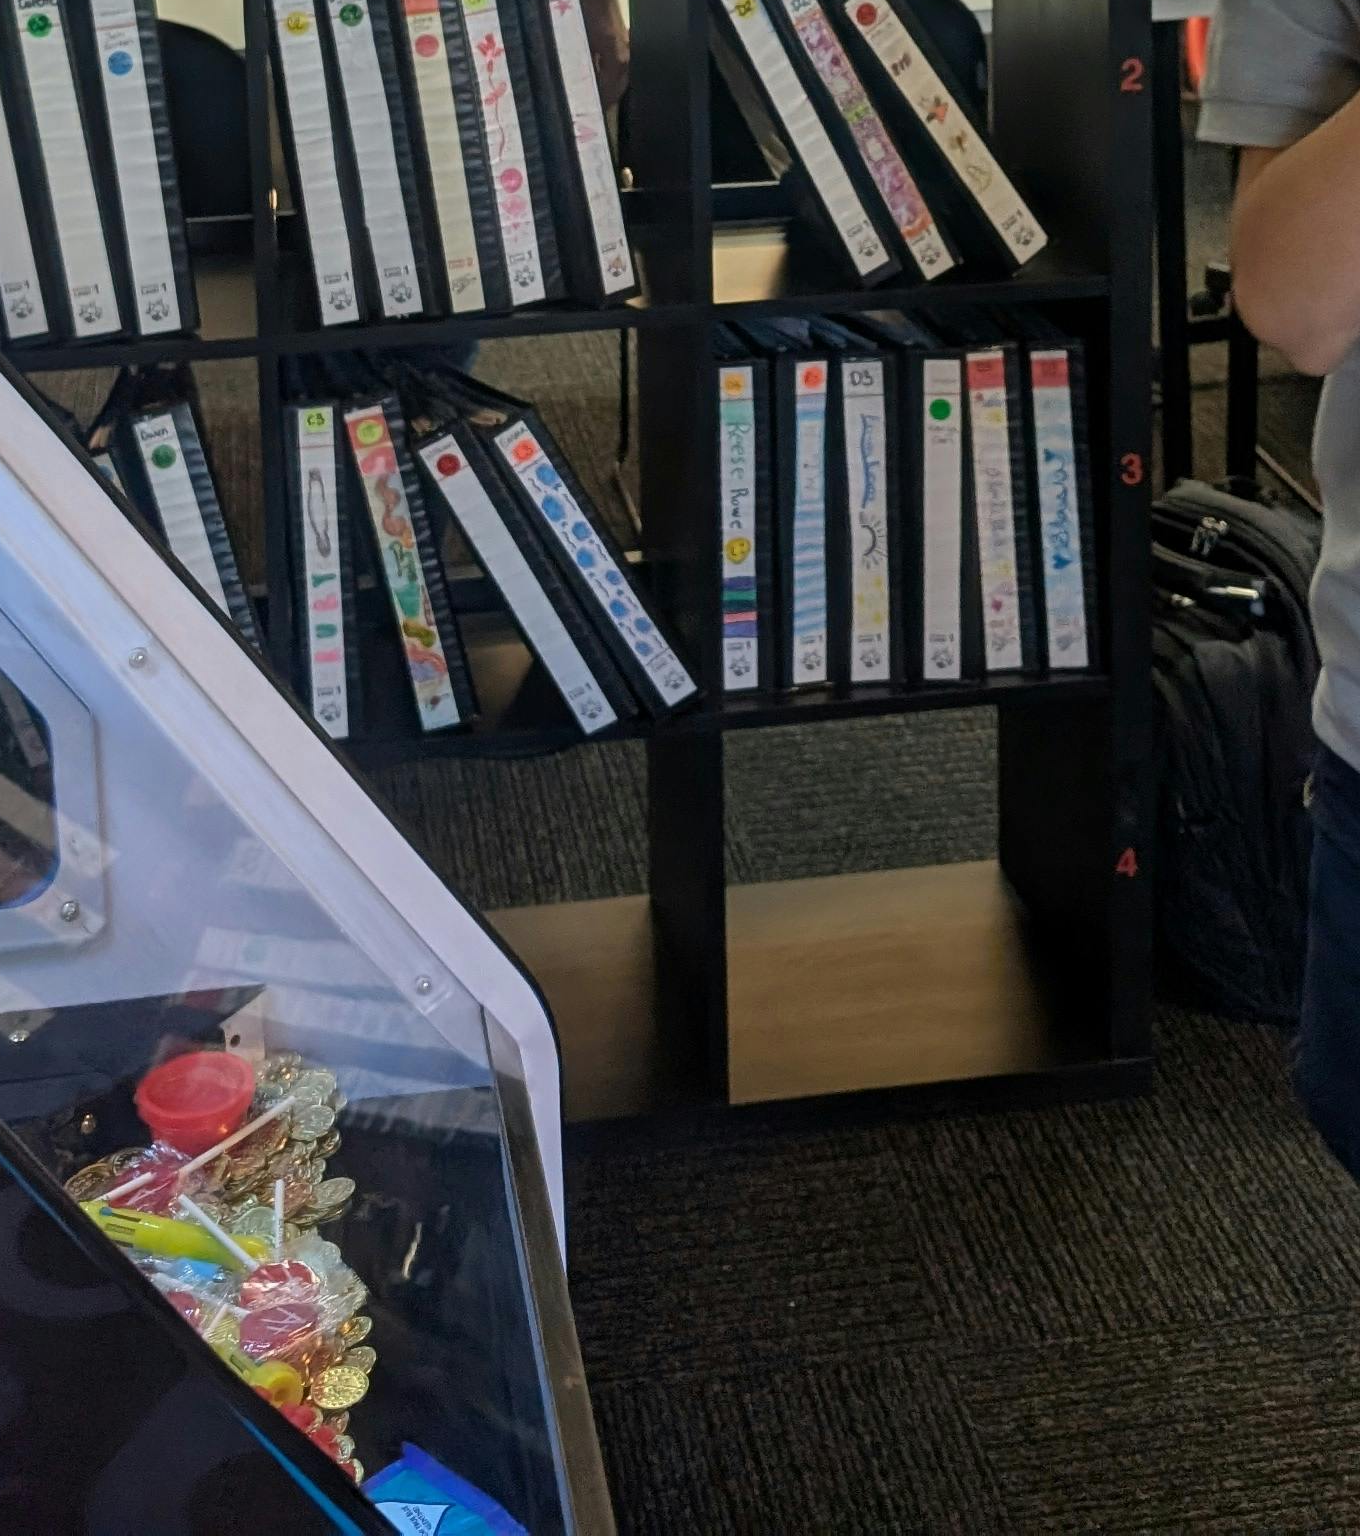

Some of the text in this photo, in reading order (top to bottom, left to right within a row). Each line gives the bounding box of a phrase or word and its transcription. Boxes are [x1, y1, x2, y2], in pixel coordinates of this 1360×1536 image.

[1120, 55, 1145, 94] 2
[1120, 452, 1145, 486] 3
[1115, 846, 1139, 878] 4
